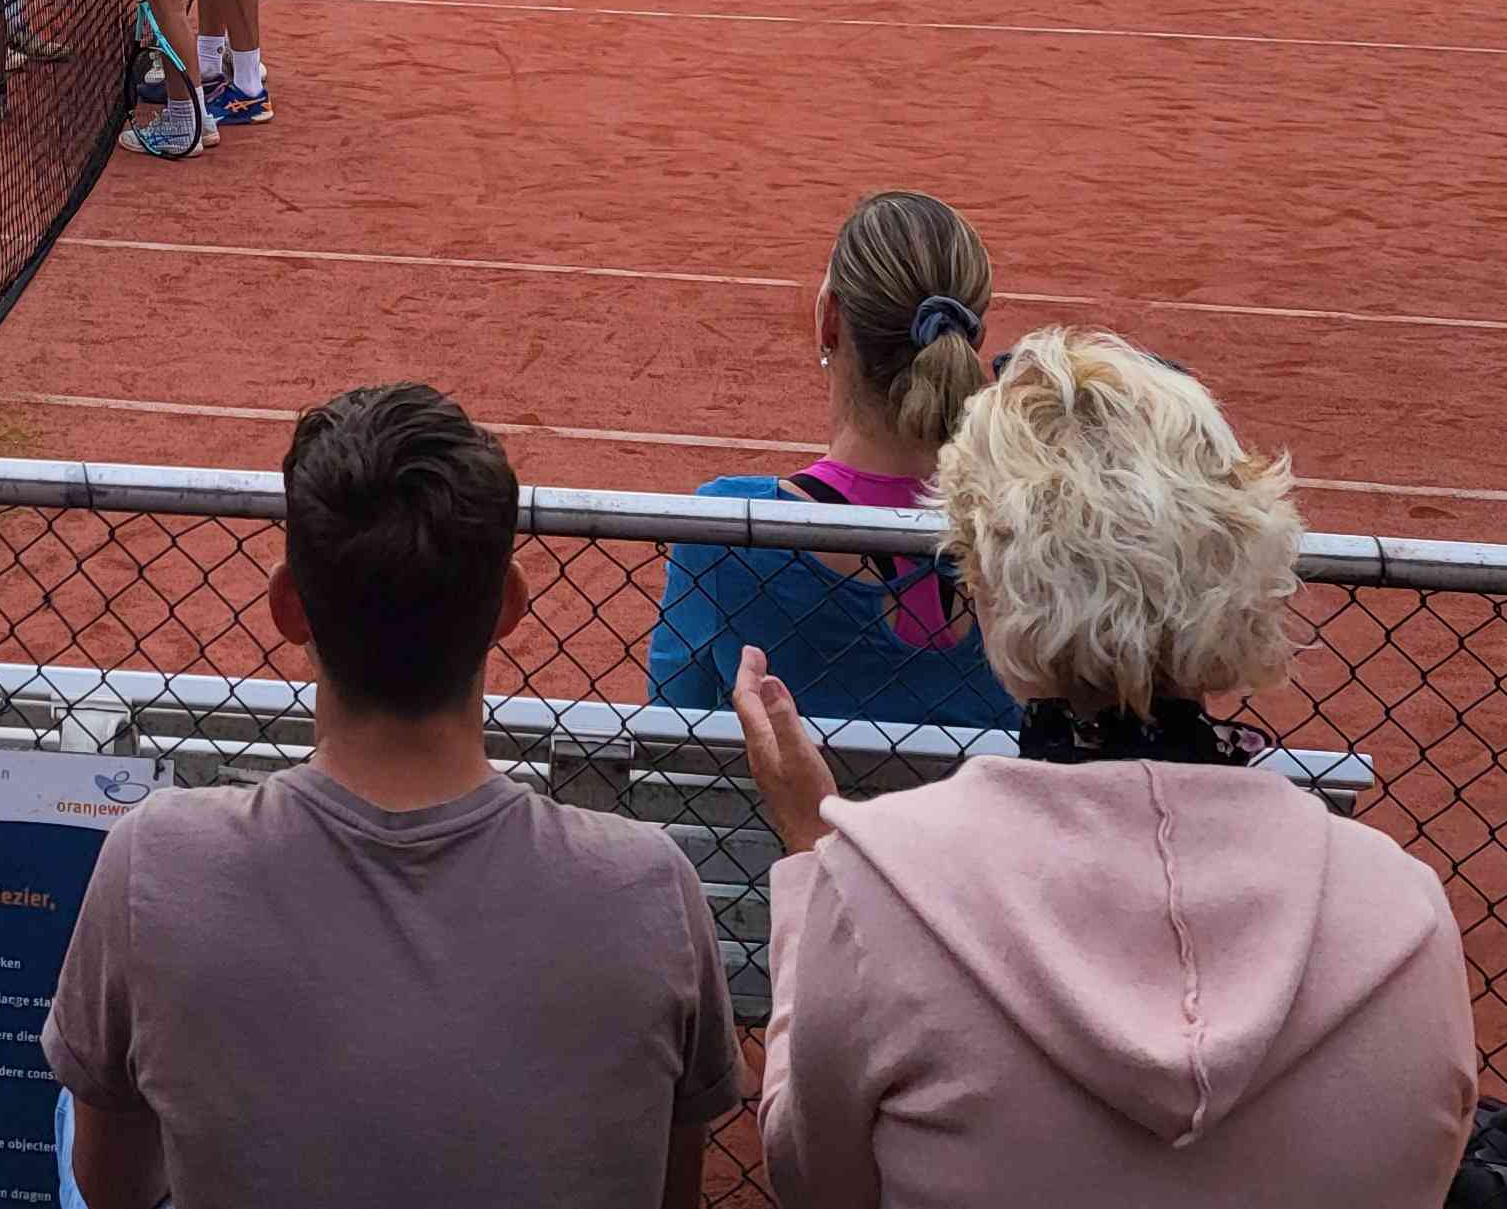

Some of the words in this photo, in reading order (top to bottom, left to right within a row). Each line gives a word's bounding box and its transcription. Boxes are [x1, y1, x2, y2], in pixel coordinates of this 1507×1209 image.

[33, 996, 52, 1008] sta
[27, 1069, 58, 1081] cons
[7, 1137, 58, 1153] objecten
[10, 1188, 53, 1203] dragen
